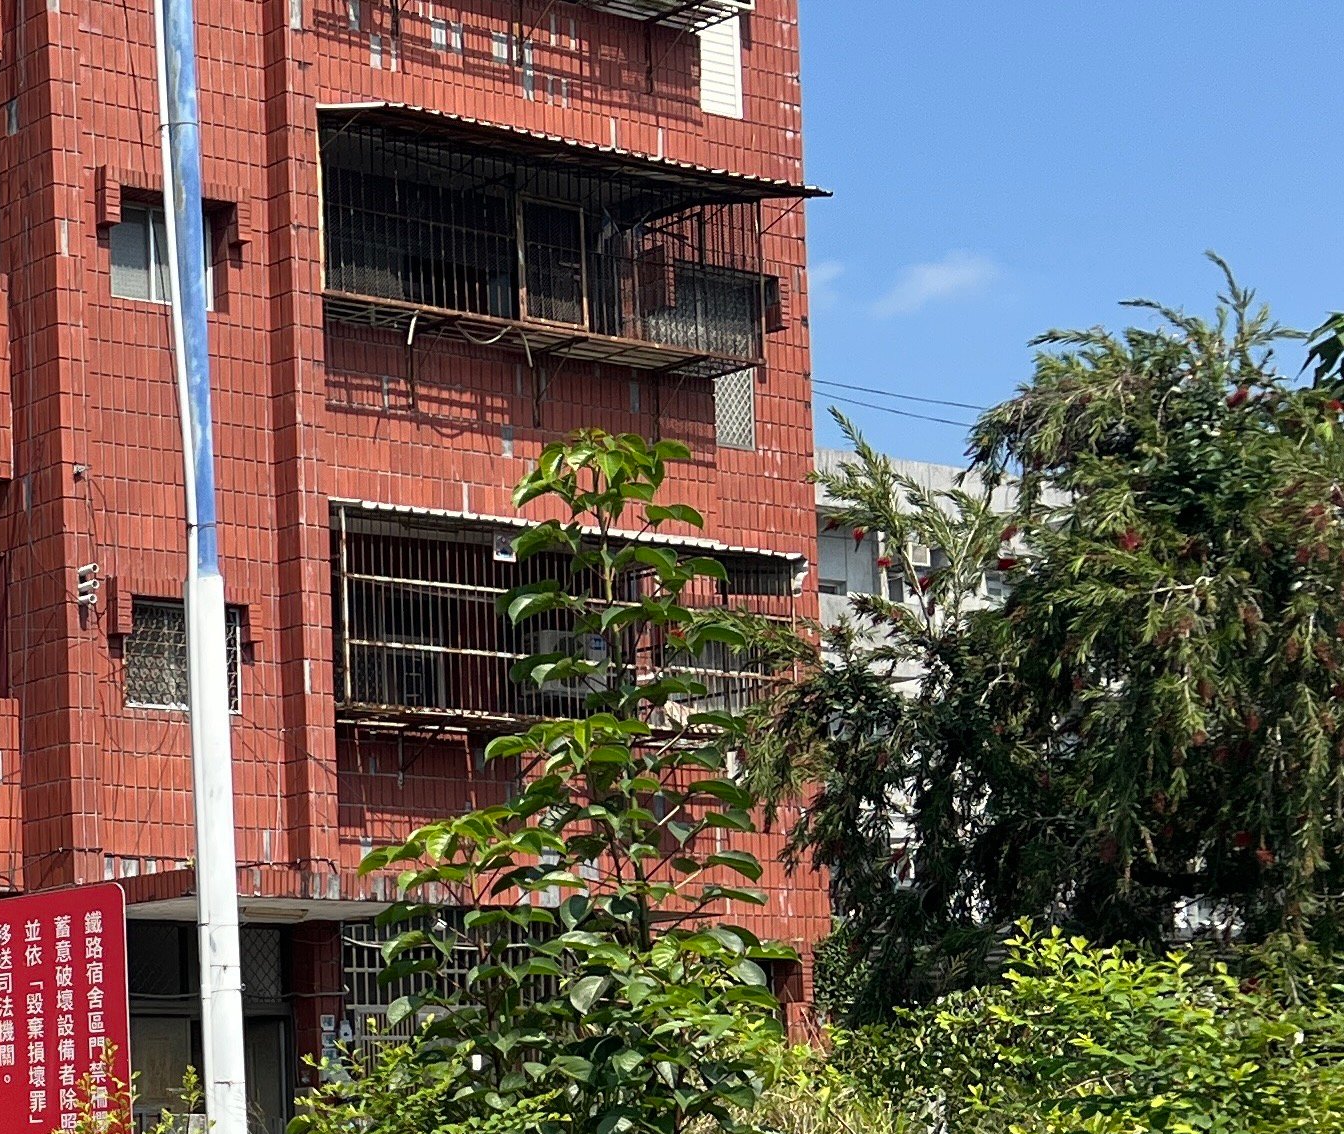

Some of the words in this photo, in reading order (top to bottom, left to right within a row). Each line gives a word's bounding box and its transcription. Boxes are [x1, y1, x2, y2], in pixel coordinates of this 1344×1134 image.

[23, 919, 47, 1124] 並依「毀棄損壞罪」
